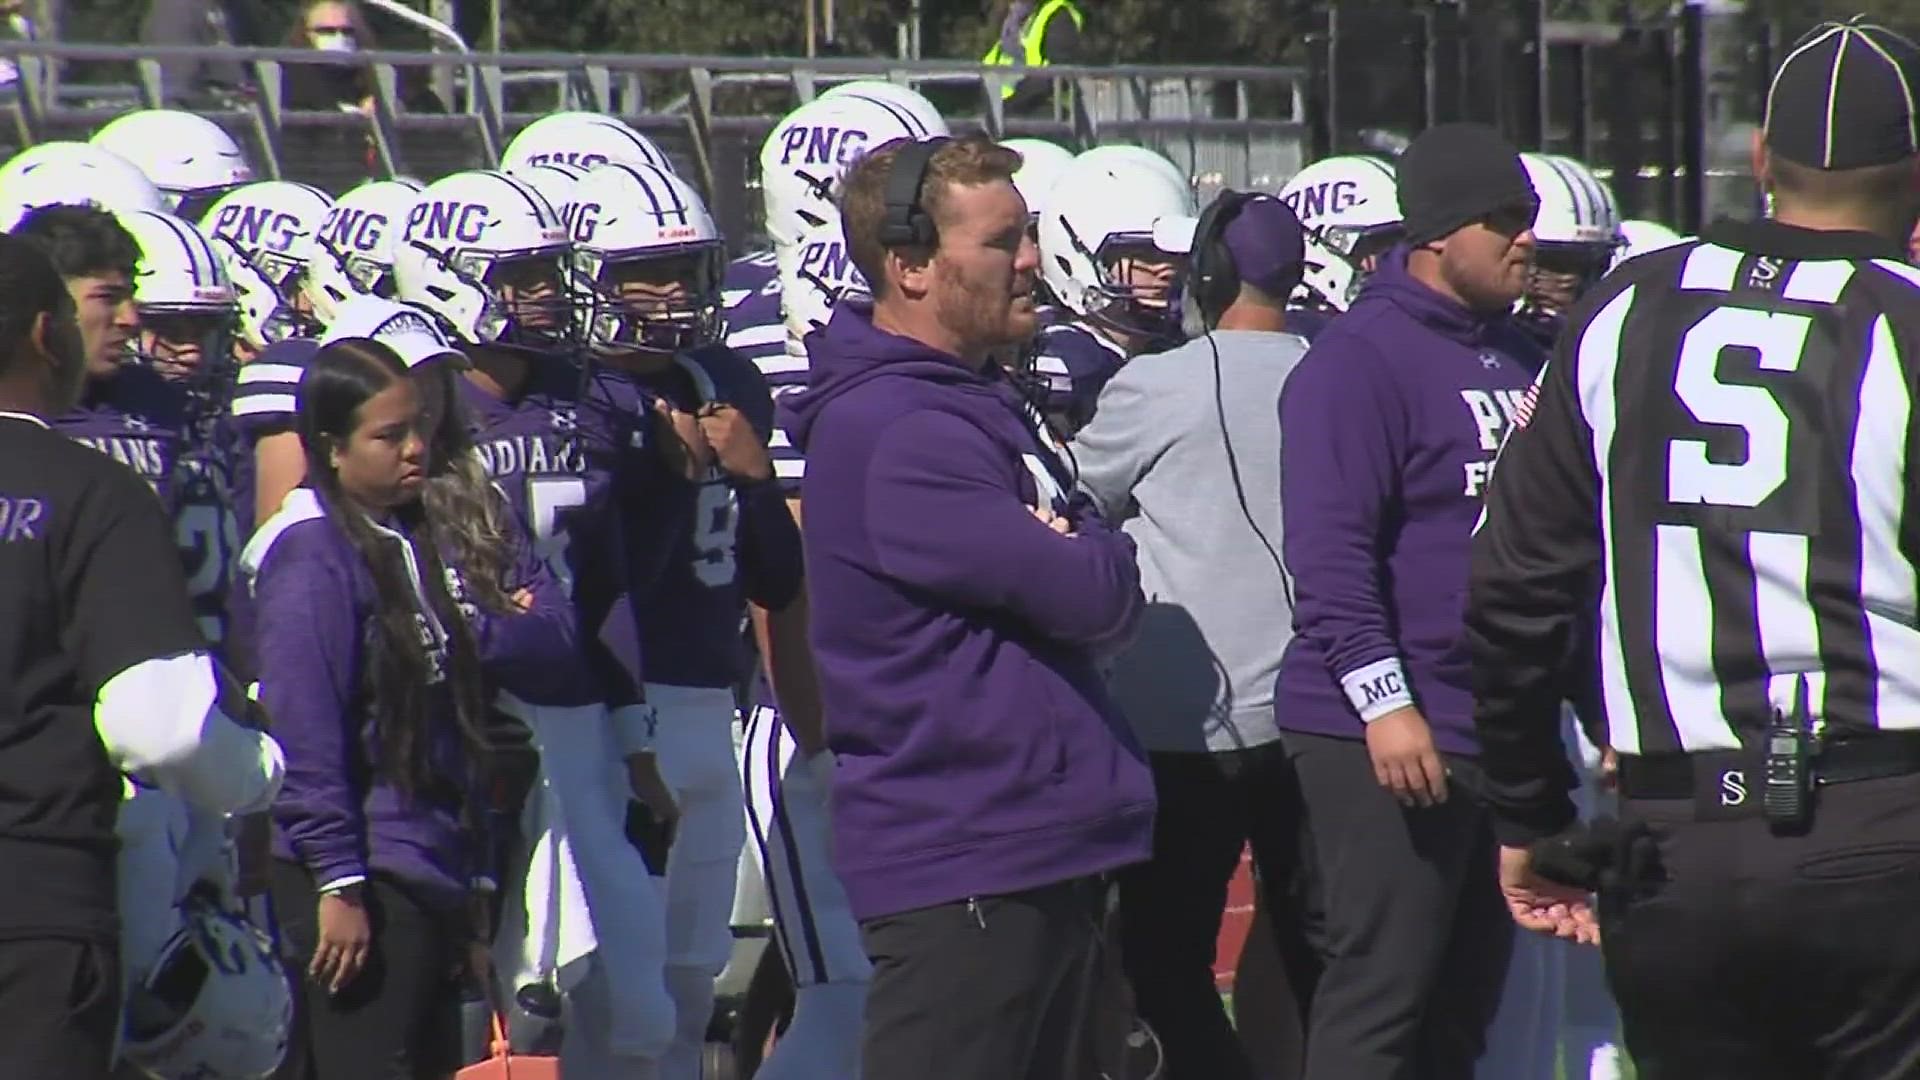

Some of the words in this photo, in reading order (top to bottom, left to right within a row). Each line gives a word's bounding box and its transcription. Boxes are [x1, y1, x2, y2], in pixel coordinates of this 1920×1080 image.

[211, 205, 300, 251] PNG
[314, 208, 388, 250] PNG
[402, 201, 489, 243] PNG
[560, 202, 601, 242] NG
[1669, 306, 1813, 508] S
[472, 435, 587, 476] NDIAN
[1360, 670, 1401, 705] MC
[1721, 771, 1747, 806] S
